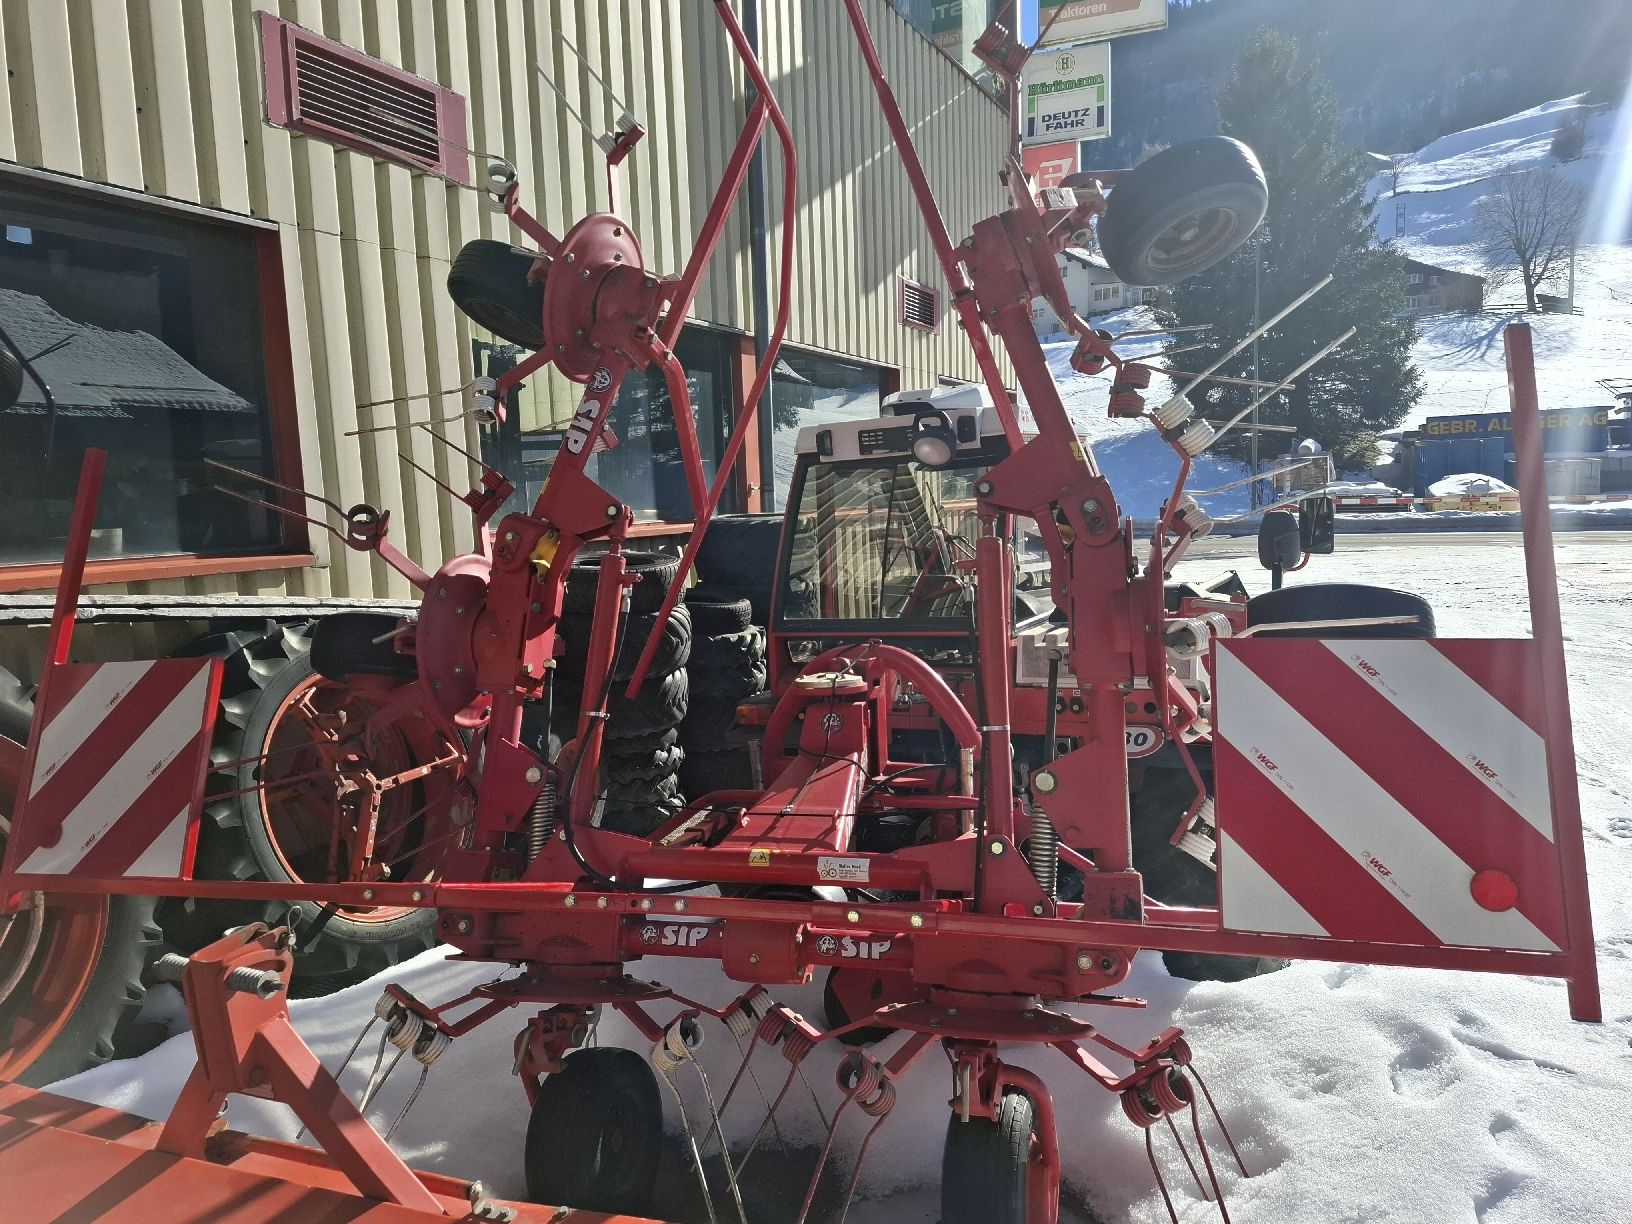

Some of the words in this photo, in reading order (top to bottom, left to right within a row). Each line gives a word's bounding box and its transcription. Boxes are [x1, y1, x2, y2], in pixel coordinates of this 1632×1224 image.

[1028, 74, 1104, 96] Hürlimann
[1042, 108, 1090, 123] DEUTZ
[1046, 119, 1085, 131] FAHR
[565, 400, 600, 454] SIP
[1428, 419, 1483, 434] GEBR.
[1580, 411, 1607, 426] AG
[1358, 660, 1381, 677] WGF
[1257, 753, 1279, 771] WGF
[1474, 760, 1498, 779] WGF
[1370, 857, 1393, 877] WGF
[662, 926, 709, 947] SIP
[841, 936, 891, 960] SIP
